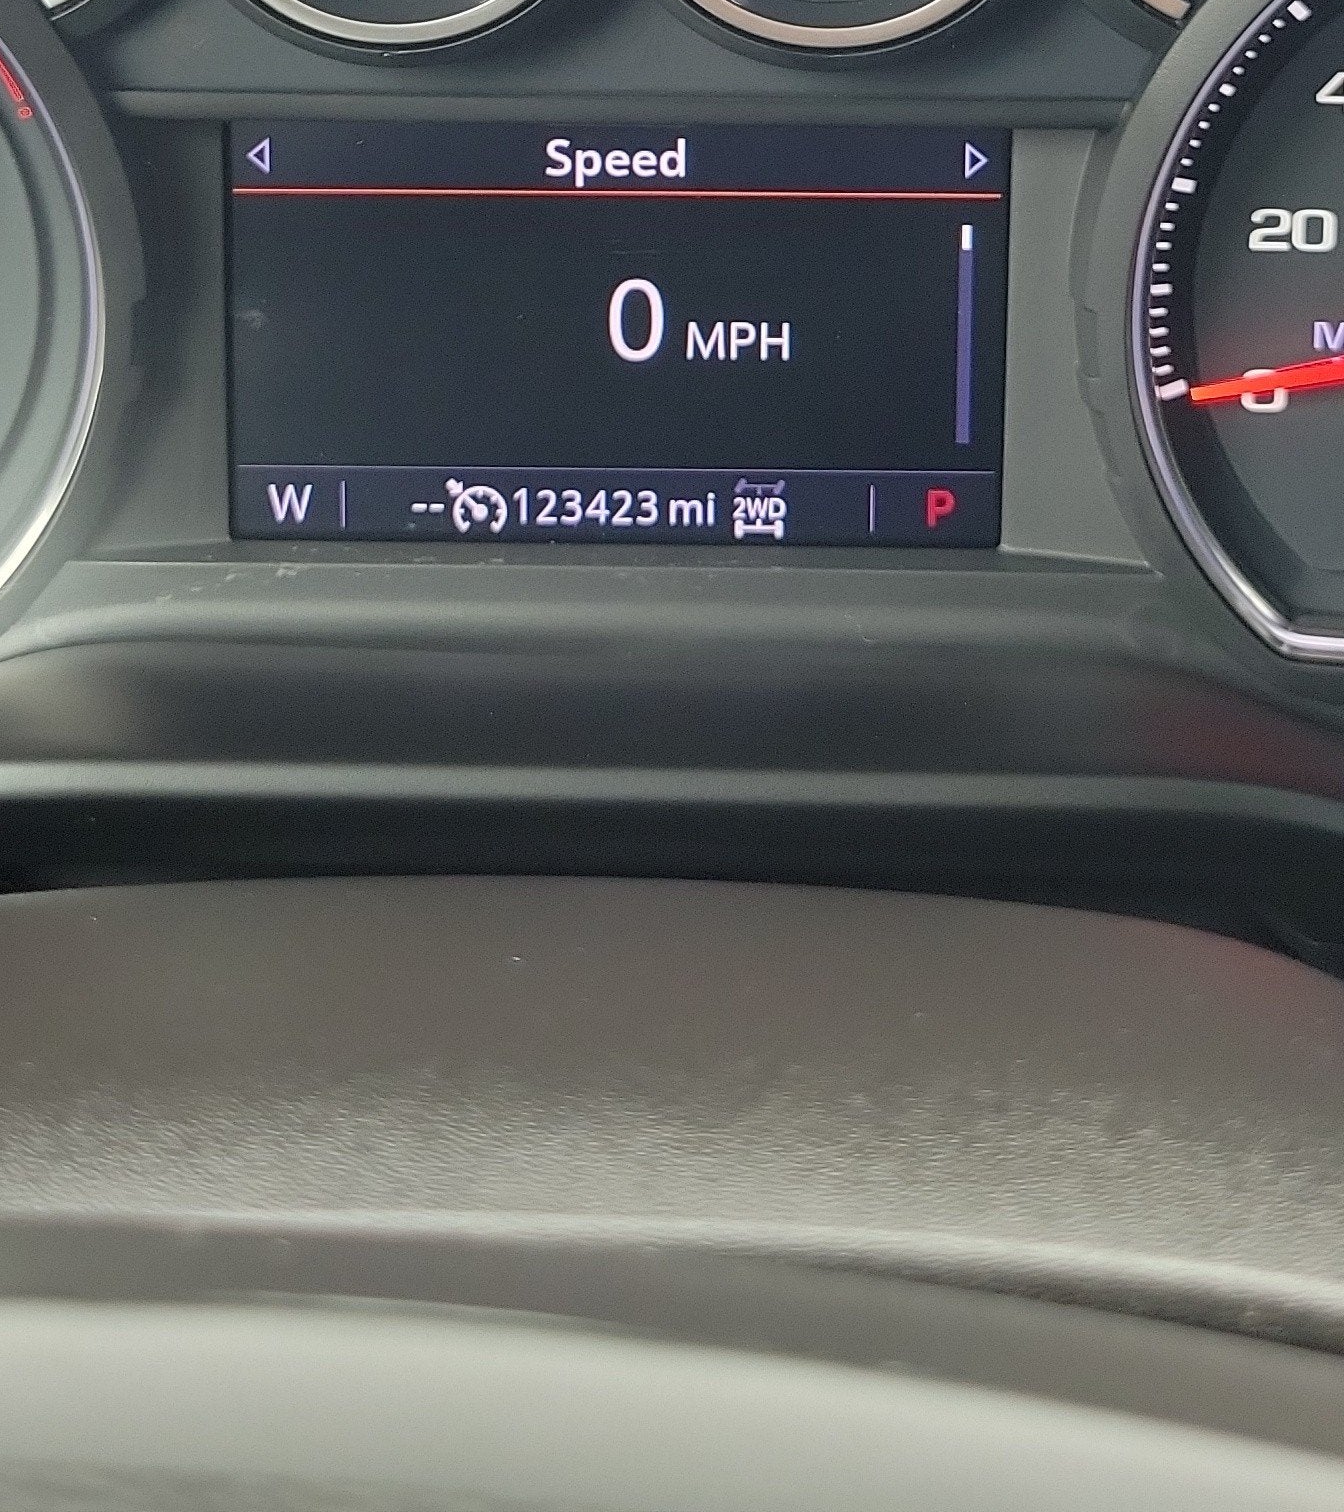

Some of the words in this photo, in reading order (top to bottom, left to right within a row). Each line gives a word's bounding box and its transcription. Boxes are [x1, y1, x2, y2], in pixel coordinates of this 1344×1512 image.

[545, 137, 686, 187] Speed
[1248, 208, 1338, 253] 20
[609, 278, 664, 362] 0
[686, 321, 790, 361] MPH
[268, 483, 313, 522] W
[513, 487, 659, 526] 123423
[669, 492, 716, 527] mi
[732, 496, 787, 520] 2WD
[928, 490, 953, 523] P
